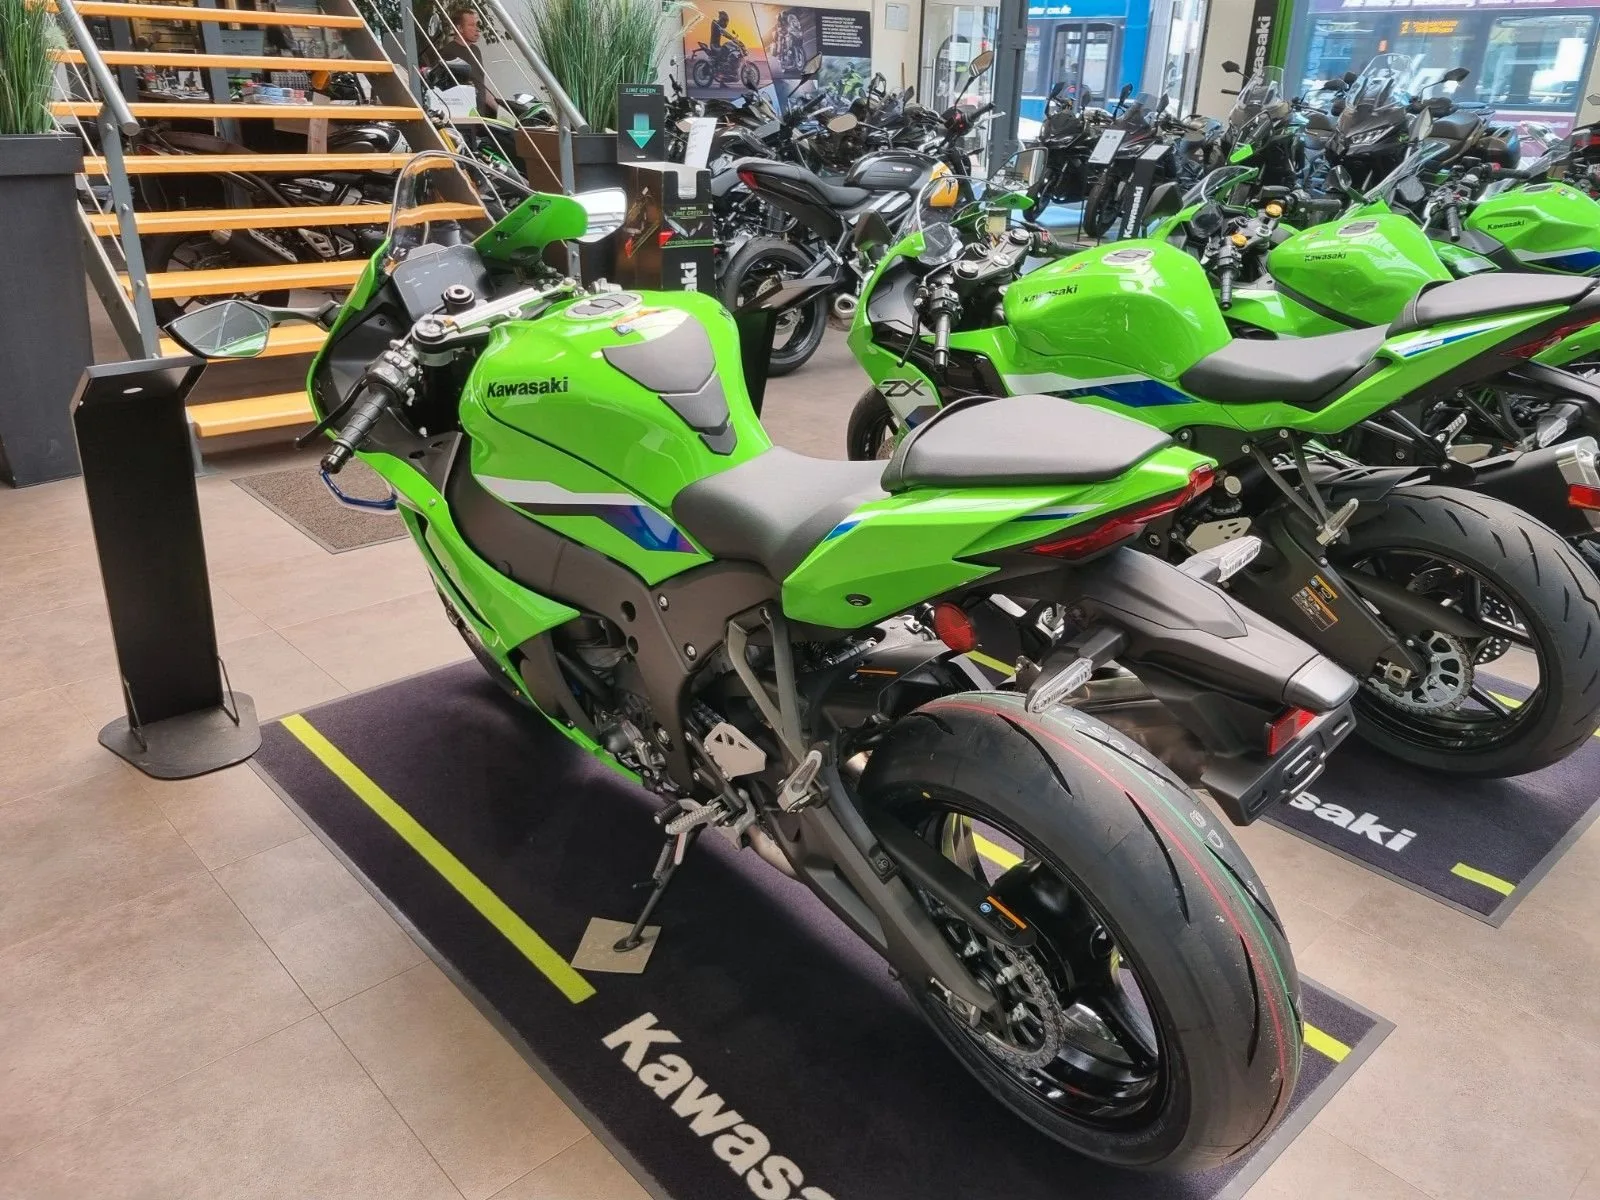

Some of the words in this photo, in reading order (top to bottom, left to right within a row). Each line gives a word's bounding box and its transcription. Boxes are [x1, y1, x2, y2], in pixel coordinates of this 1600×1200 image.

[1123, 186, 1144, 238] Kawasaki
[1487, 219, 1525, 230] Kawasaki
[1304, 251, 1347, 262] Kawasaki
[487, 377, 569, 398] Kawasaki
[882, 379, 926, 397] ZX
[1288, 791, 1418, 852] saki
[601, 1011, 836, 1200] Kawas
